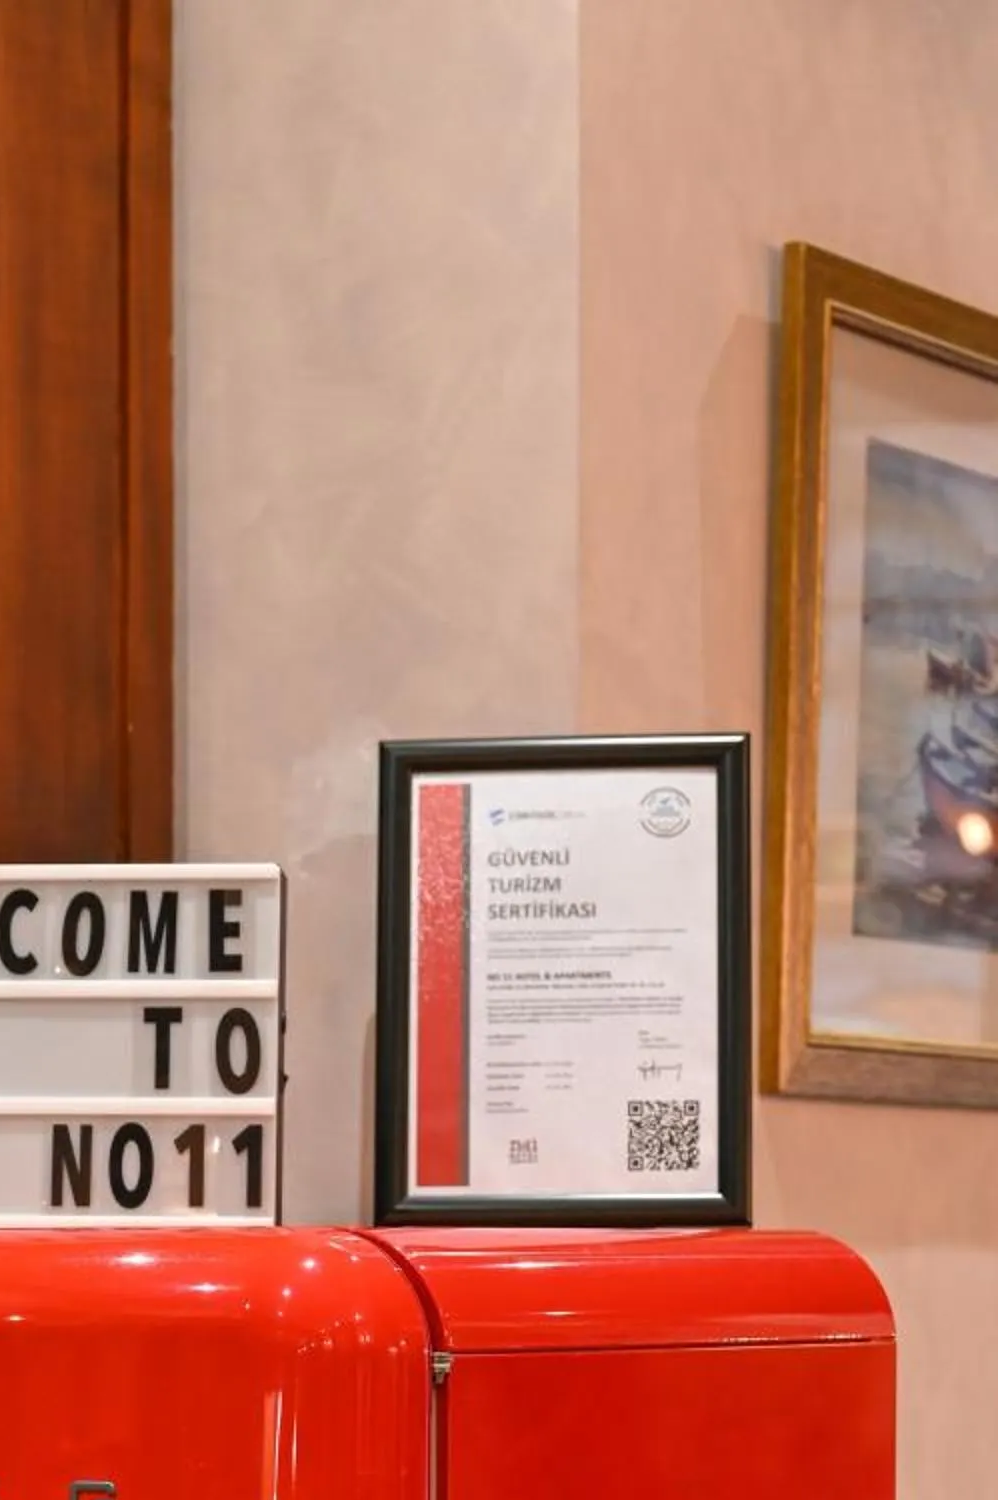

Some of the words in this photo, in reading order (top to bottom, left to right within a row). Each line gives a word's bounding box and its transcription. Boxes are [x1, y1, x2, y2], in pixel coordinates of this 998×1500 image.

[487, 847, 570, 867] GÜVENLİ
[488, 873, 562, 894] TURİZM
[488, 899, 597, 920] SERTİFİKASI
[143, 1006, 261, 1095] TO
[50, 1122, 263, 1209] NO11
